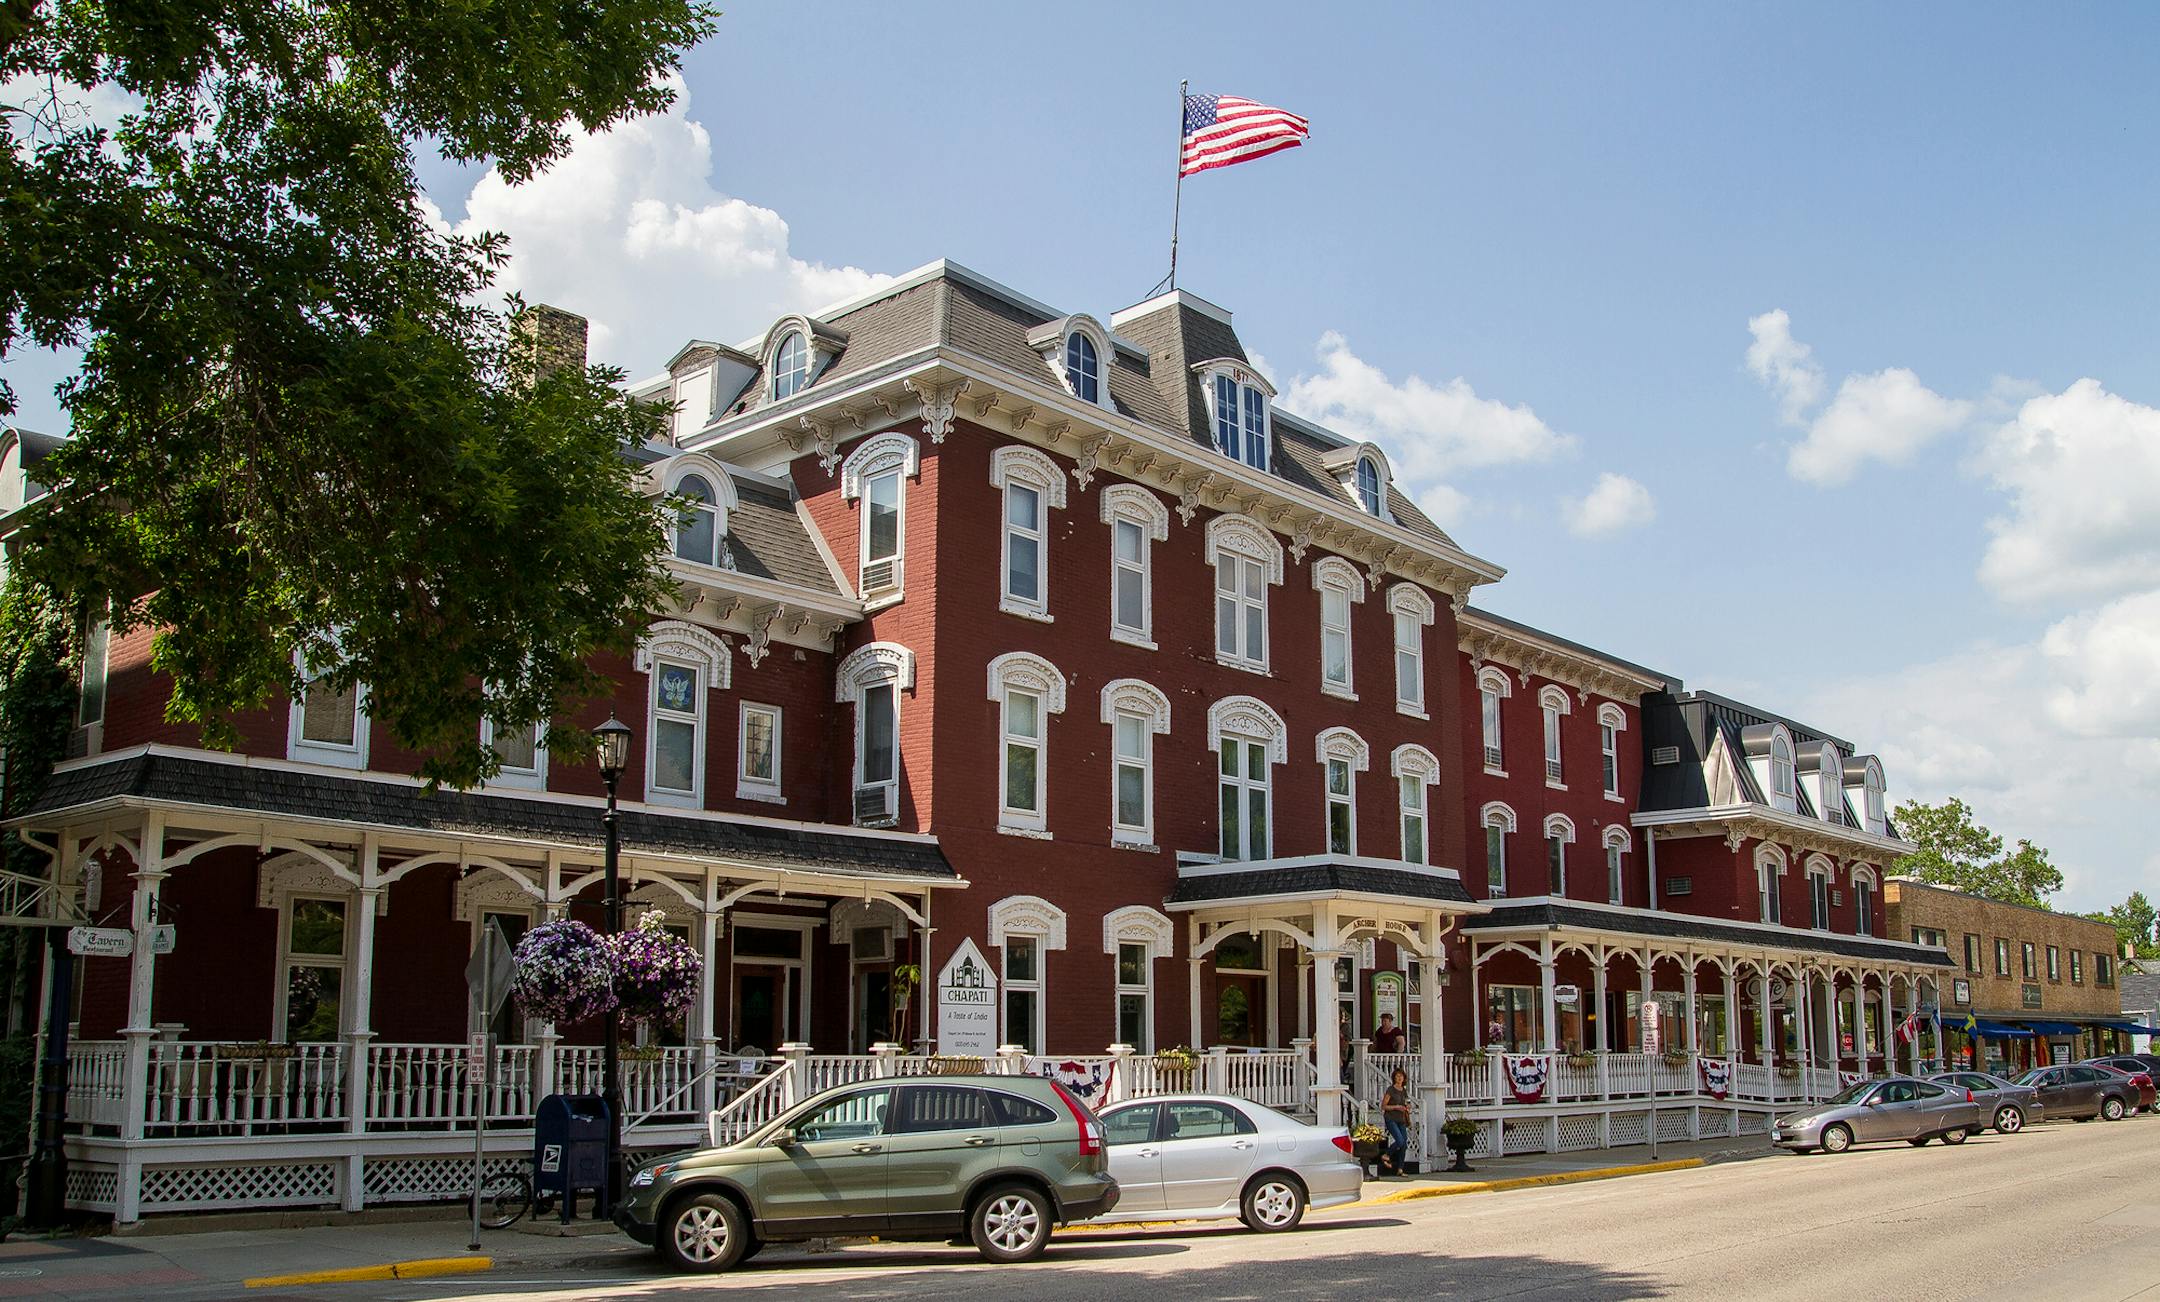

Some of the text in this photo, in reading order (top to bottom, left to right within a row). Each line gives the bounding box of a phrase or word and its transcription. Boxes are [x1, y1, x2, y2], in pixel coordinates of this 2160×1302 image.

[1233, 368, 1249, 383] 1877
[1353, 919, 1407, 933] ARCHER HOUSE
[88, 932, 125, 946] Tavern
[947, 990, 988, 1002] CHAPATI
[953, 1011, 966, 1020] Taste
[967, 1012, 973, 1020] of
[974, 1012, 988, 1020] India
